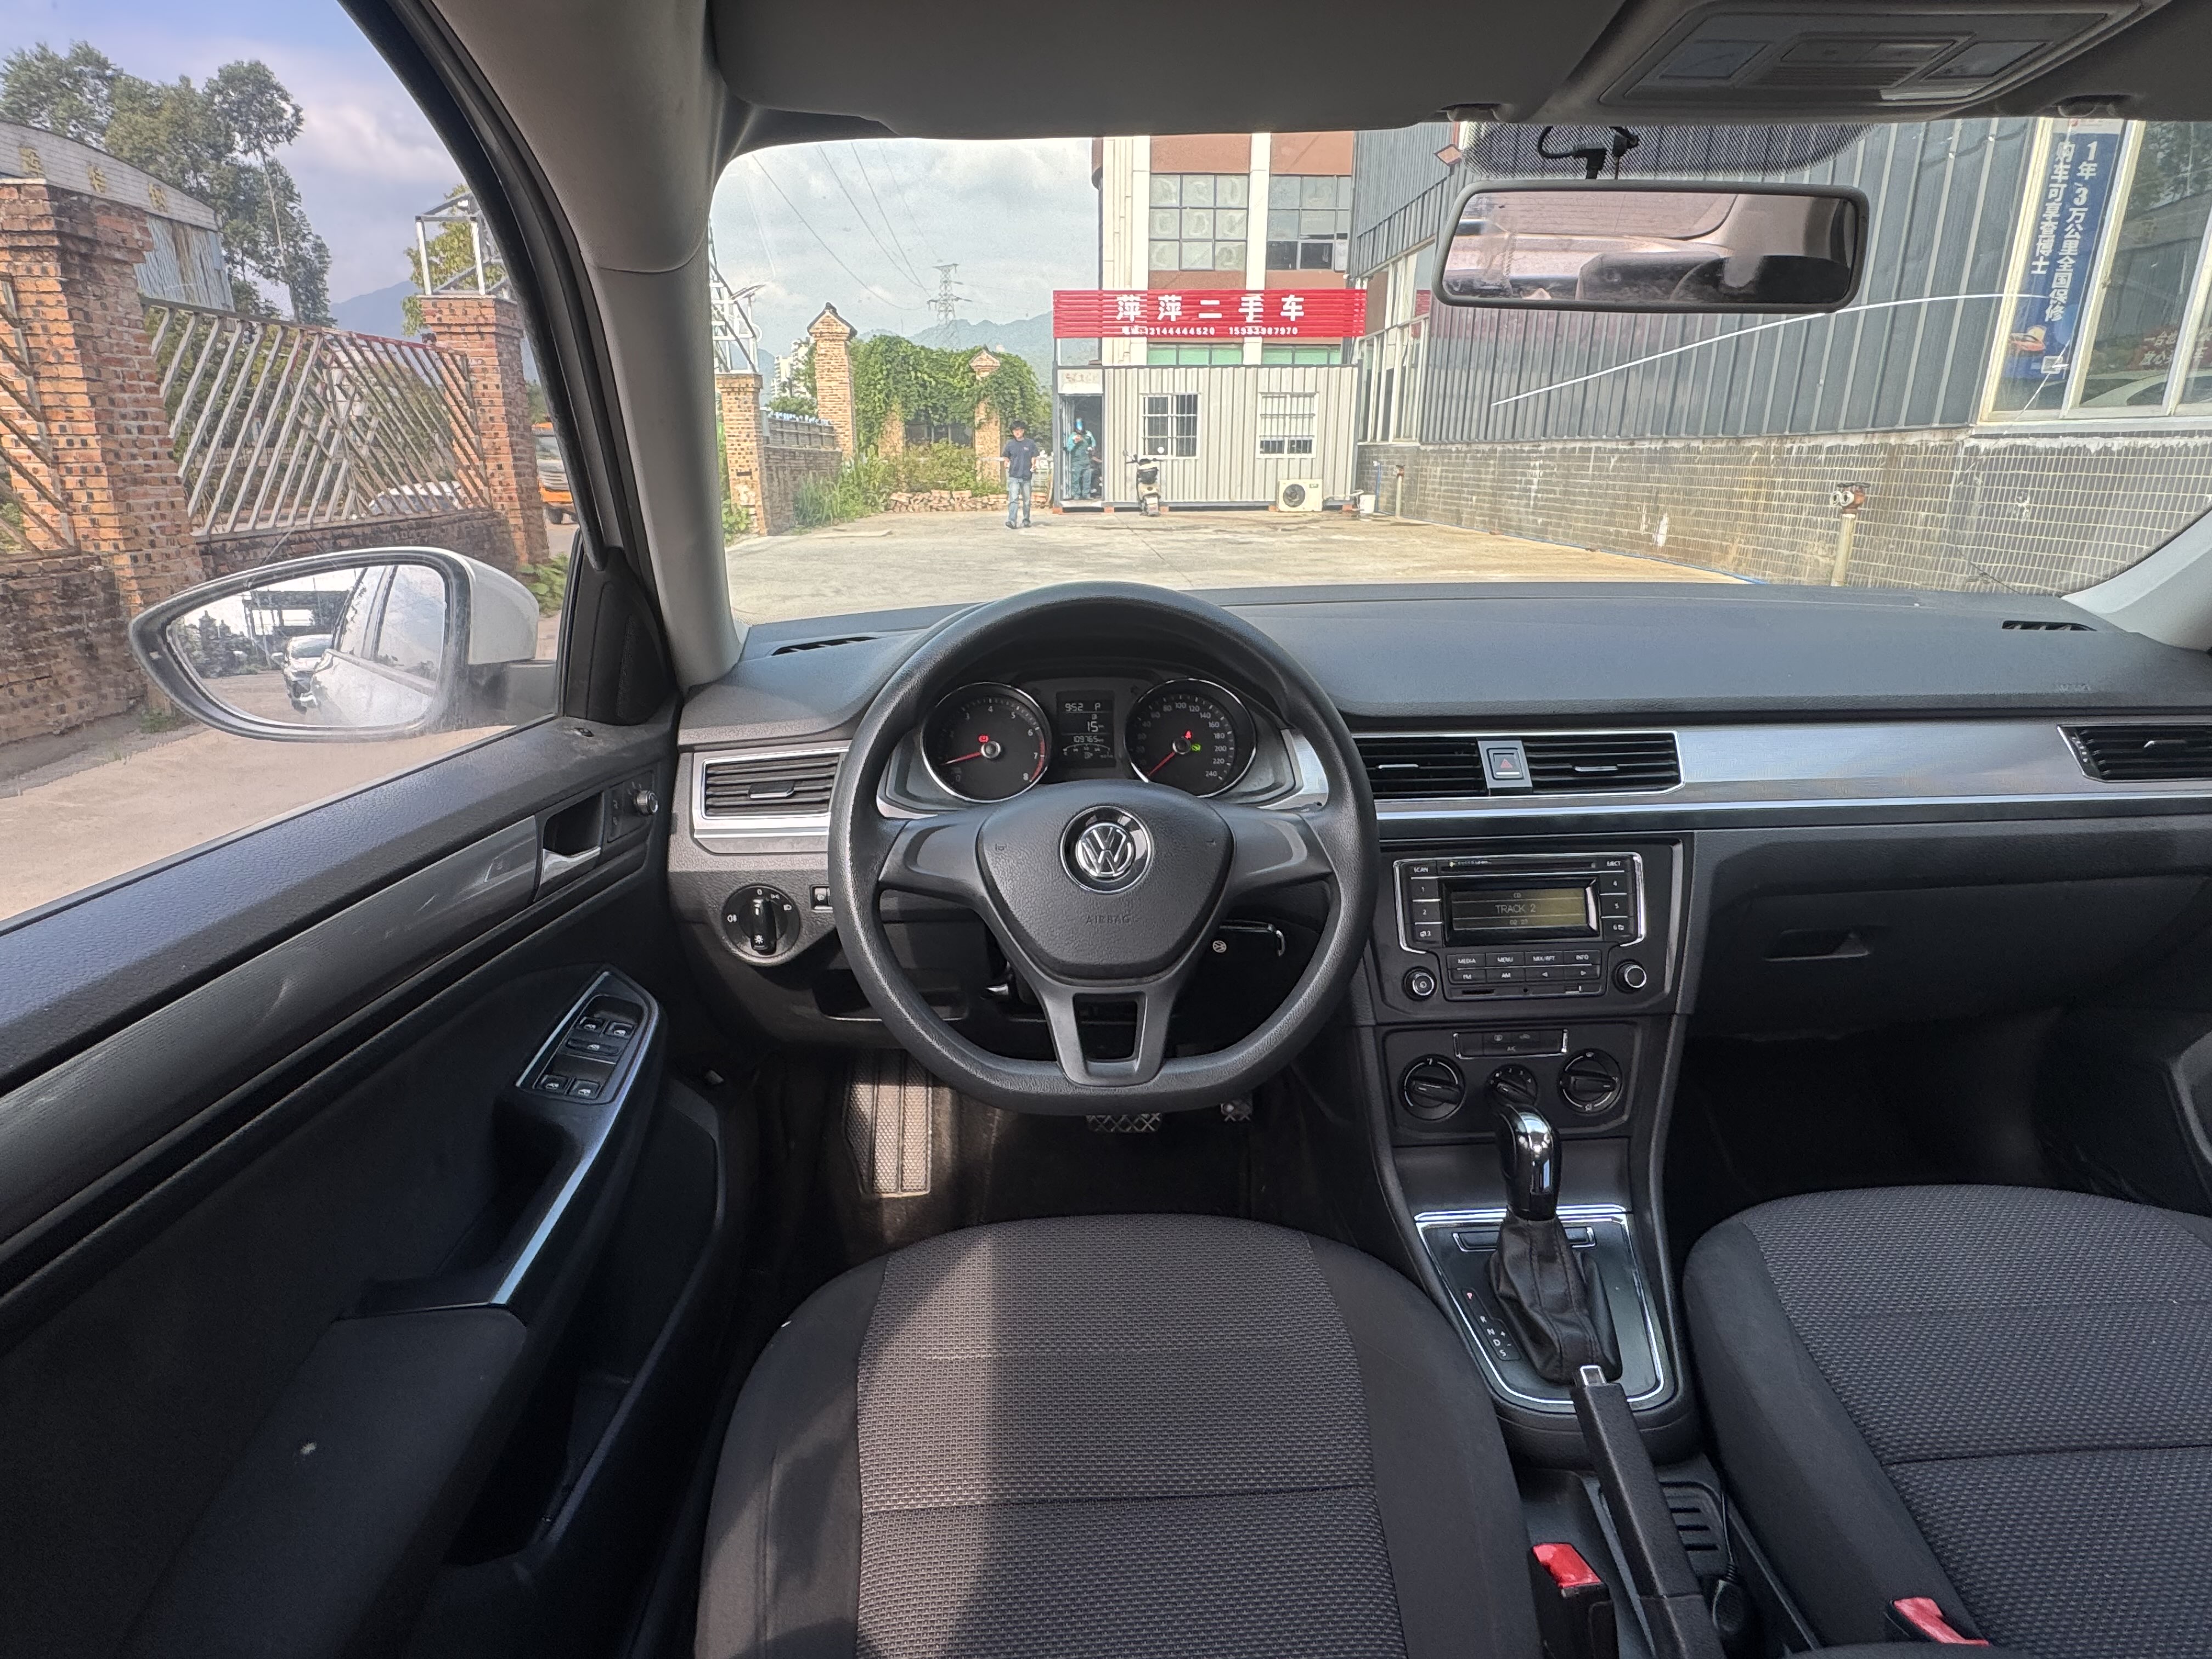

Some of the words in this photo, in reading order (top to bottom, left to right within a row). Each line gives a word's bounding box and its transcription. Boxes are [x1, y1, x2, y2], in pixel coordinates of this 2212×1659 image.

[2031, 141, 2076, 274] 购车可享查博士
[1116, 295, 1305, 322] 萍萍二手车
[1494, 904, 1525, 914] TRACK
[1530, 904, 1536, 913] 2
[1085, 914, 1131, 924] AIRBAG
